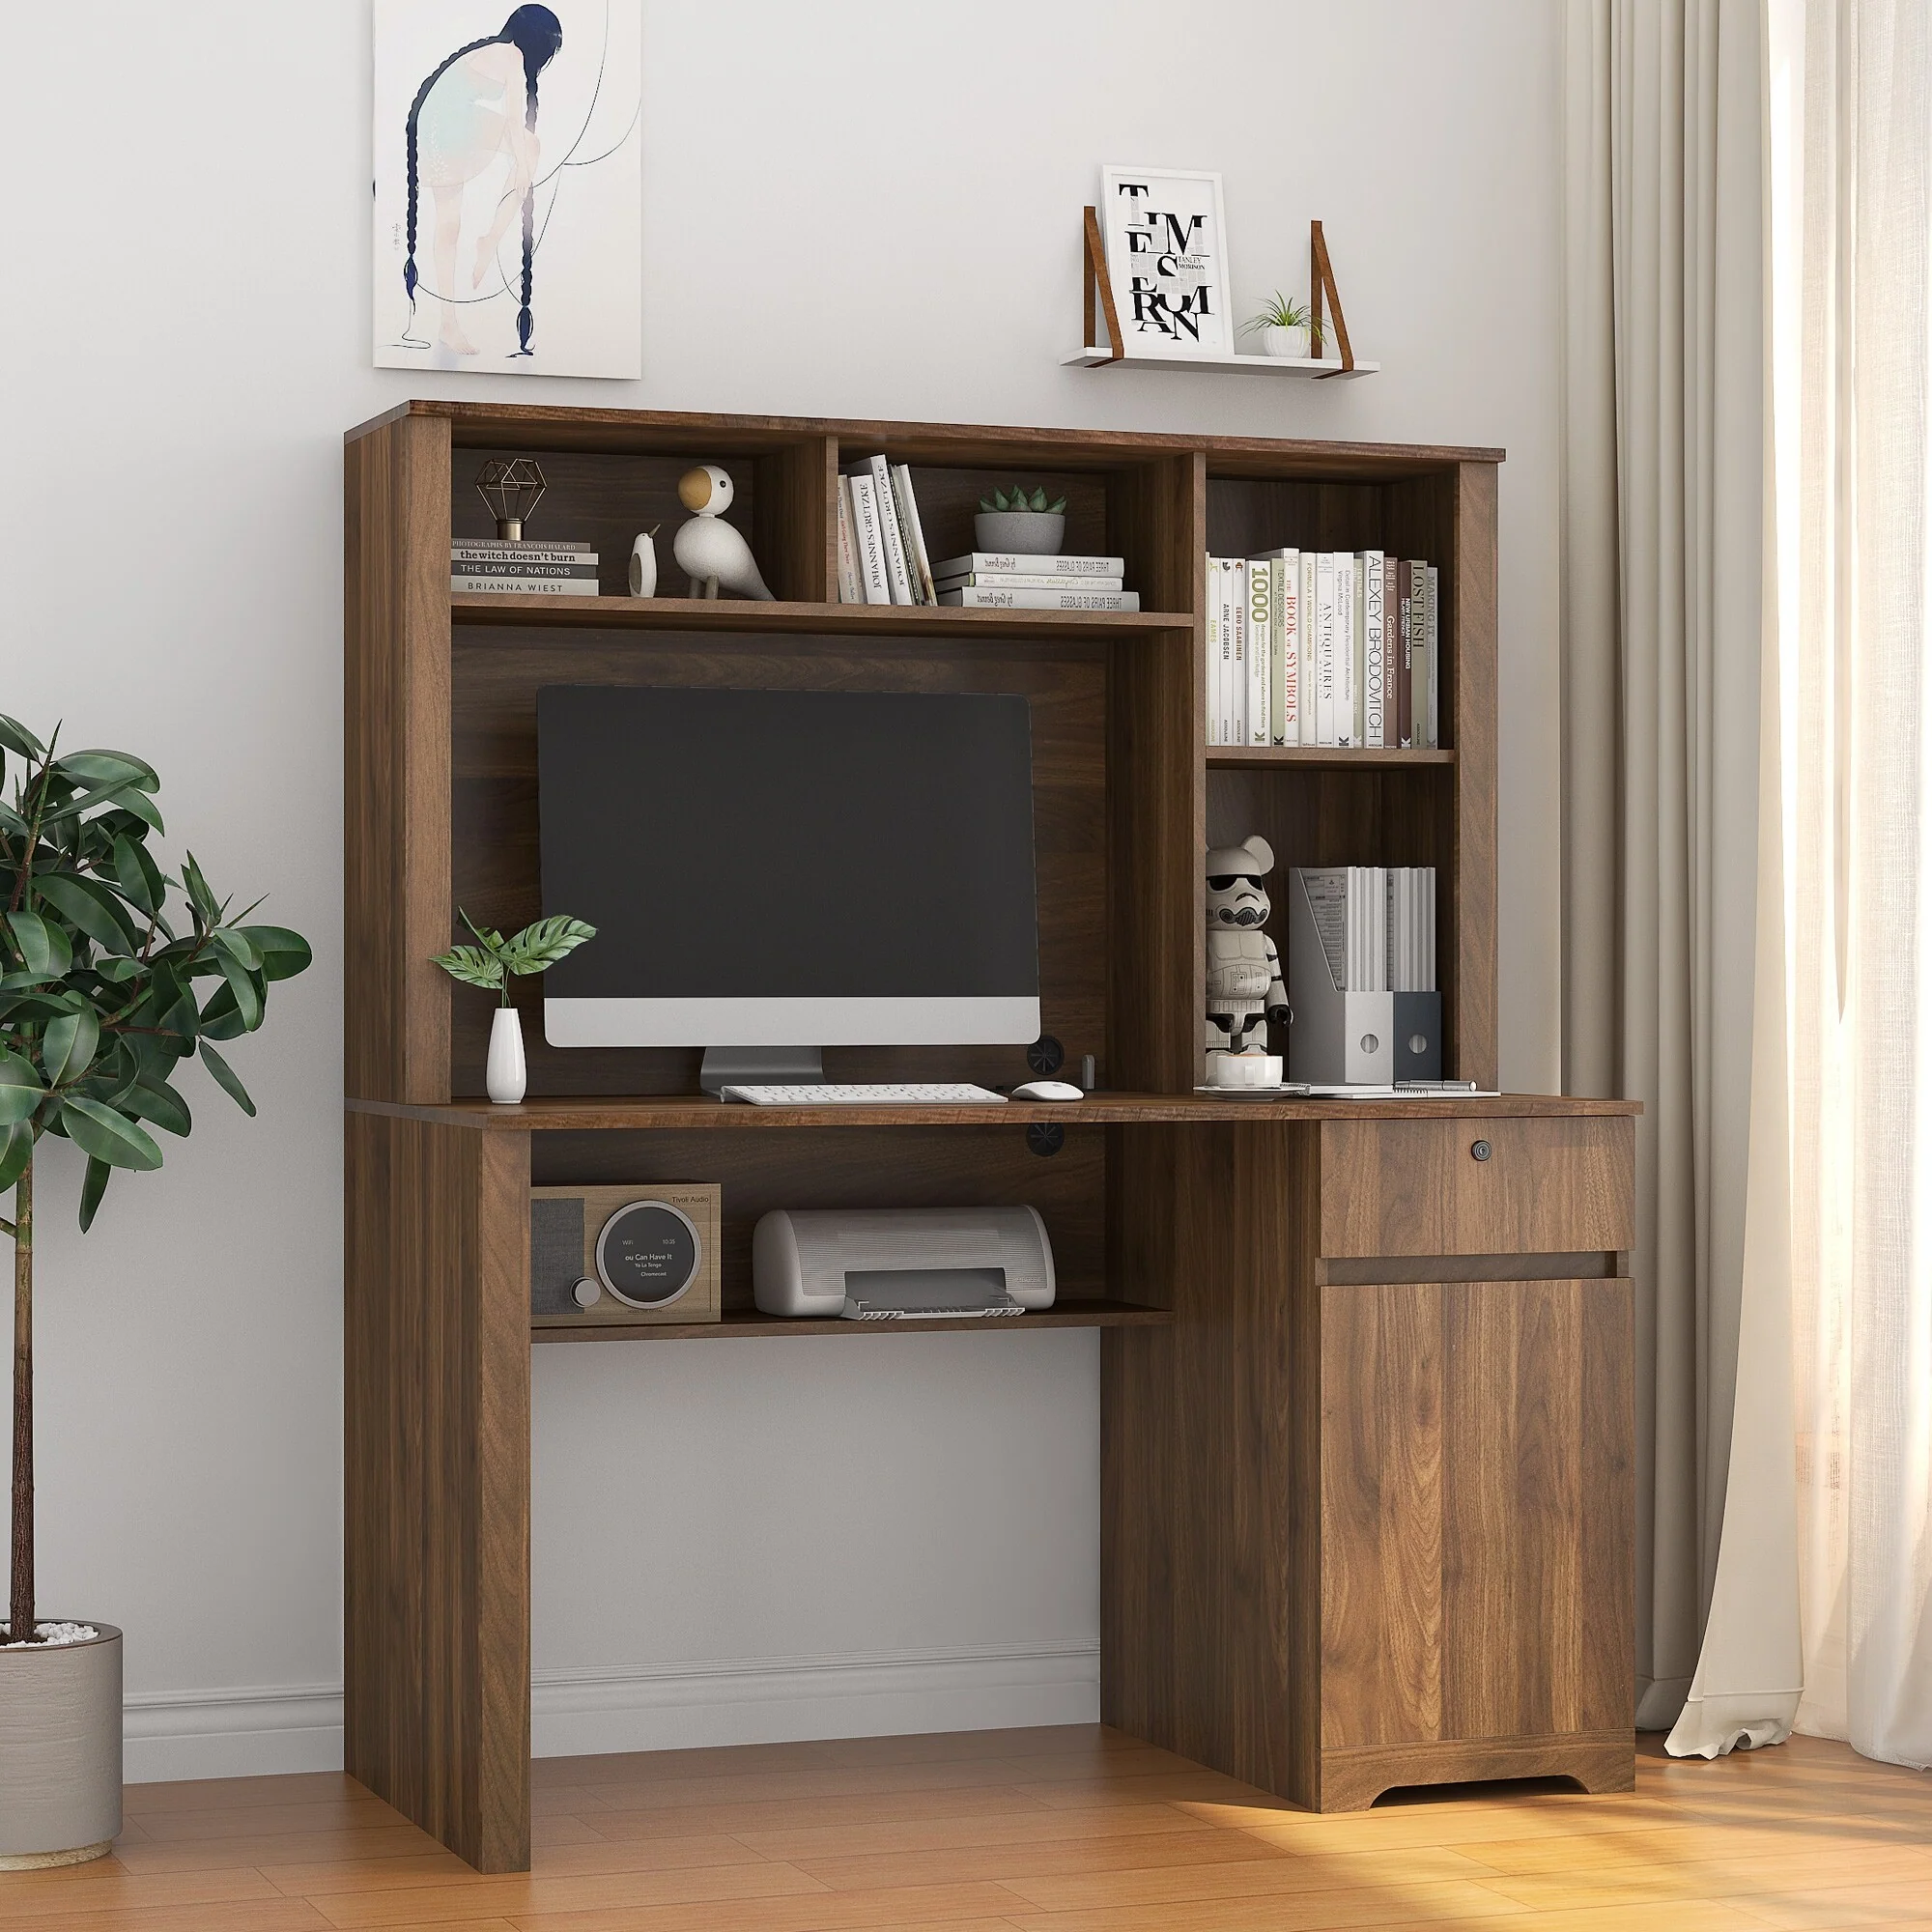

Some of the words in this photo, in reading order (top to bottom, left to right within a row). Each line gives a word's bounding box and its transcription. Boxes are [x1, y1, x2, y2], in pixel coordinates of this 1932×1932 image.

[460, 551, 478, 559] the
[479, 551, 509, 560] witch
[551, 553, 576, 562] burn
[461, 564, 481, 573] THE
[485, 565, 506, 574] LAW
[526, 566, 571, 576] NATIONS
[867, 534, 882, 589] JOHANNES
[889, 523, 906, 586] JOHANNES
[468, 582, 523, 591] BRIANNA
[527, 583, 563, 592] WIEST
[1251, 568, 1268, 623] 1000
[1368, 555, 1381, 622] ALEXEY
[1412, 565, 1425, 608] LOST
[1427, 576, 1435, 622] MAKING
[1286, 596, 1296, 636] BOOK
[1386, 615, 1395, 654] Gardens
[1412, 612, 1425, 648] FISH
[1427, 625, 1435, 637] IT
[1321, 603, 1332, 699] ANTIQUAIRES
[1386, 656, 1395, 666] in
[1286, 651, 1296, 723] SYMBOLS
[1368, 628, 1381, 738] BRODOVITCH
[1386, 668, 1395, 699] France
